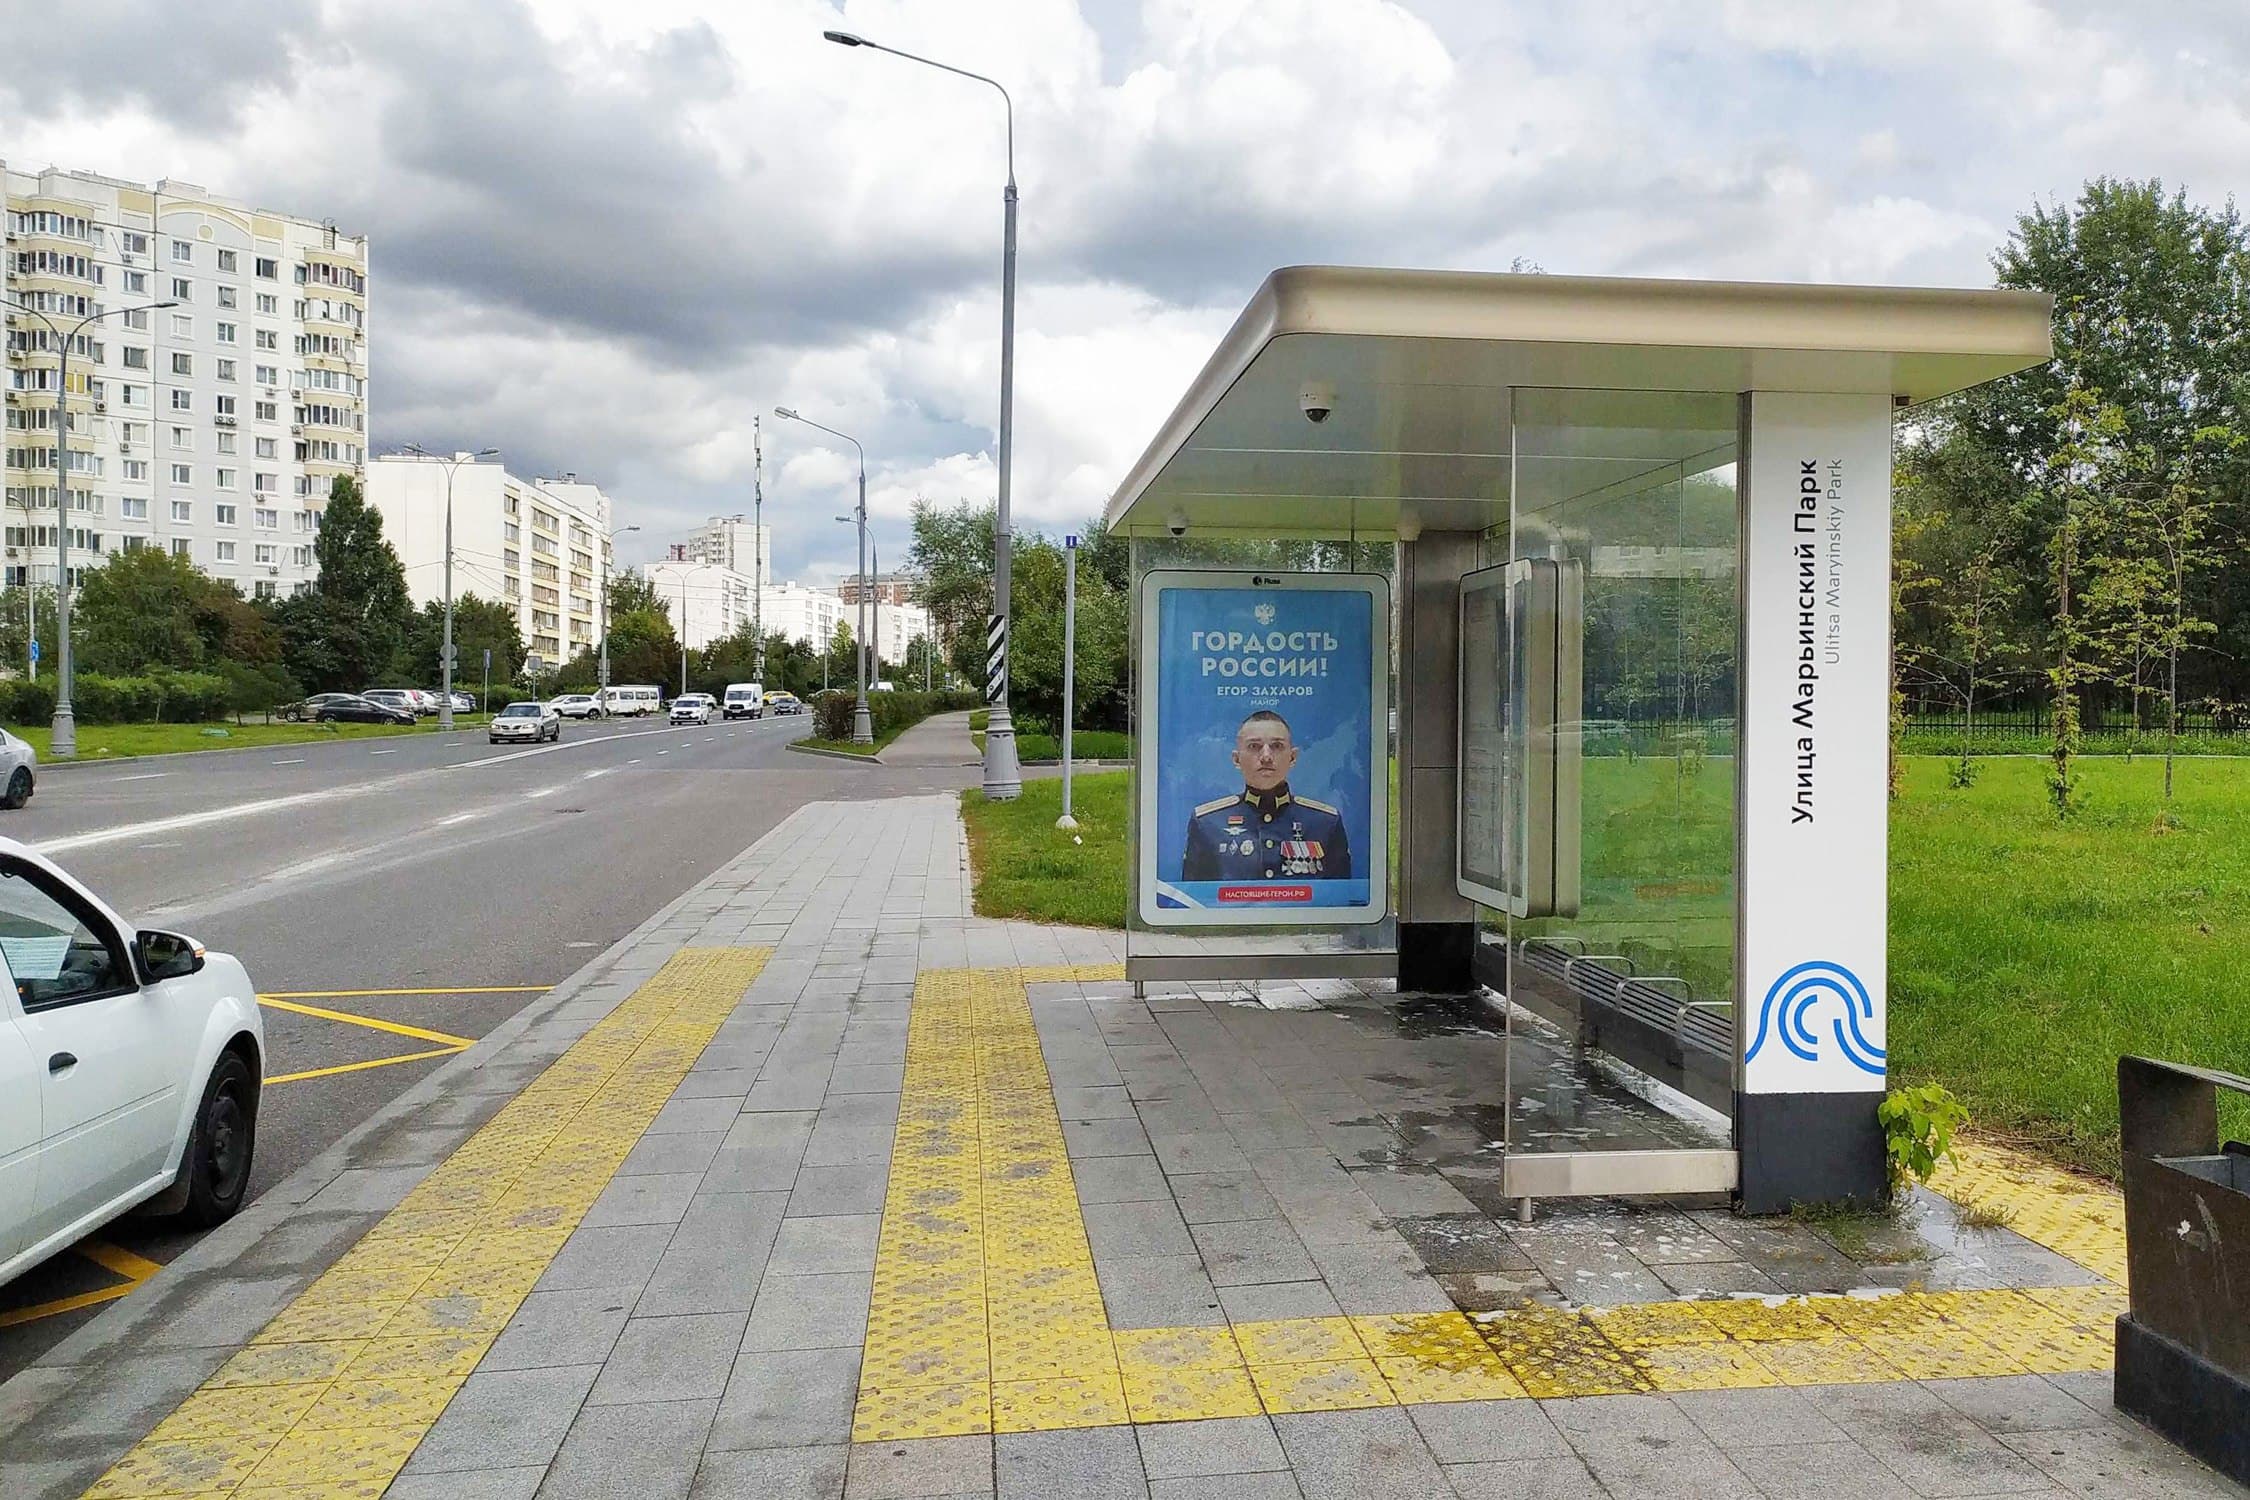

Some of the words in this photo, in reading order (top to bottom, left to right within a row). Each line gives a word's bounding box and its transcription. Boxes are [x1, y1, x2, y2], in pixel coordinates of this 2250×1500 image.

[1794, 460, 1821, 532] Парк
[1826, 459, 1843, 499] Park
[1825, 506, 1843, 606] Maryinskiy
[1192, 632, 1338, 653] ГОРДОСТЬ
[1793, 544, 1818, 728] Марьинский
[1825, 615, 1840, 663] Ulitsa
[1202, 658, 1328, 677] РОССИИ!
[1217, 687, 1248, 696] ЕГОР
[1252, 686, 1313, 696] ЗАХАРОВ
[1791, 738, 1816, 823] Улица
